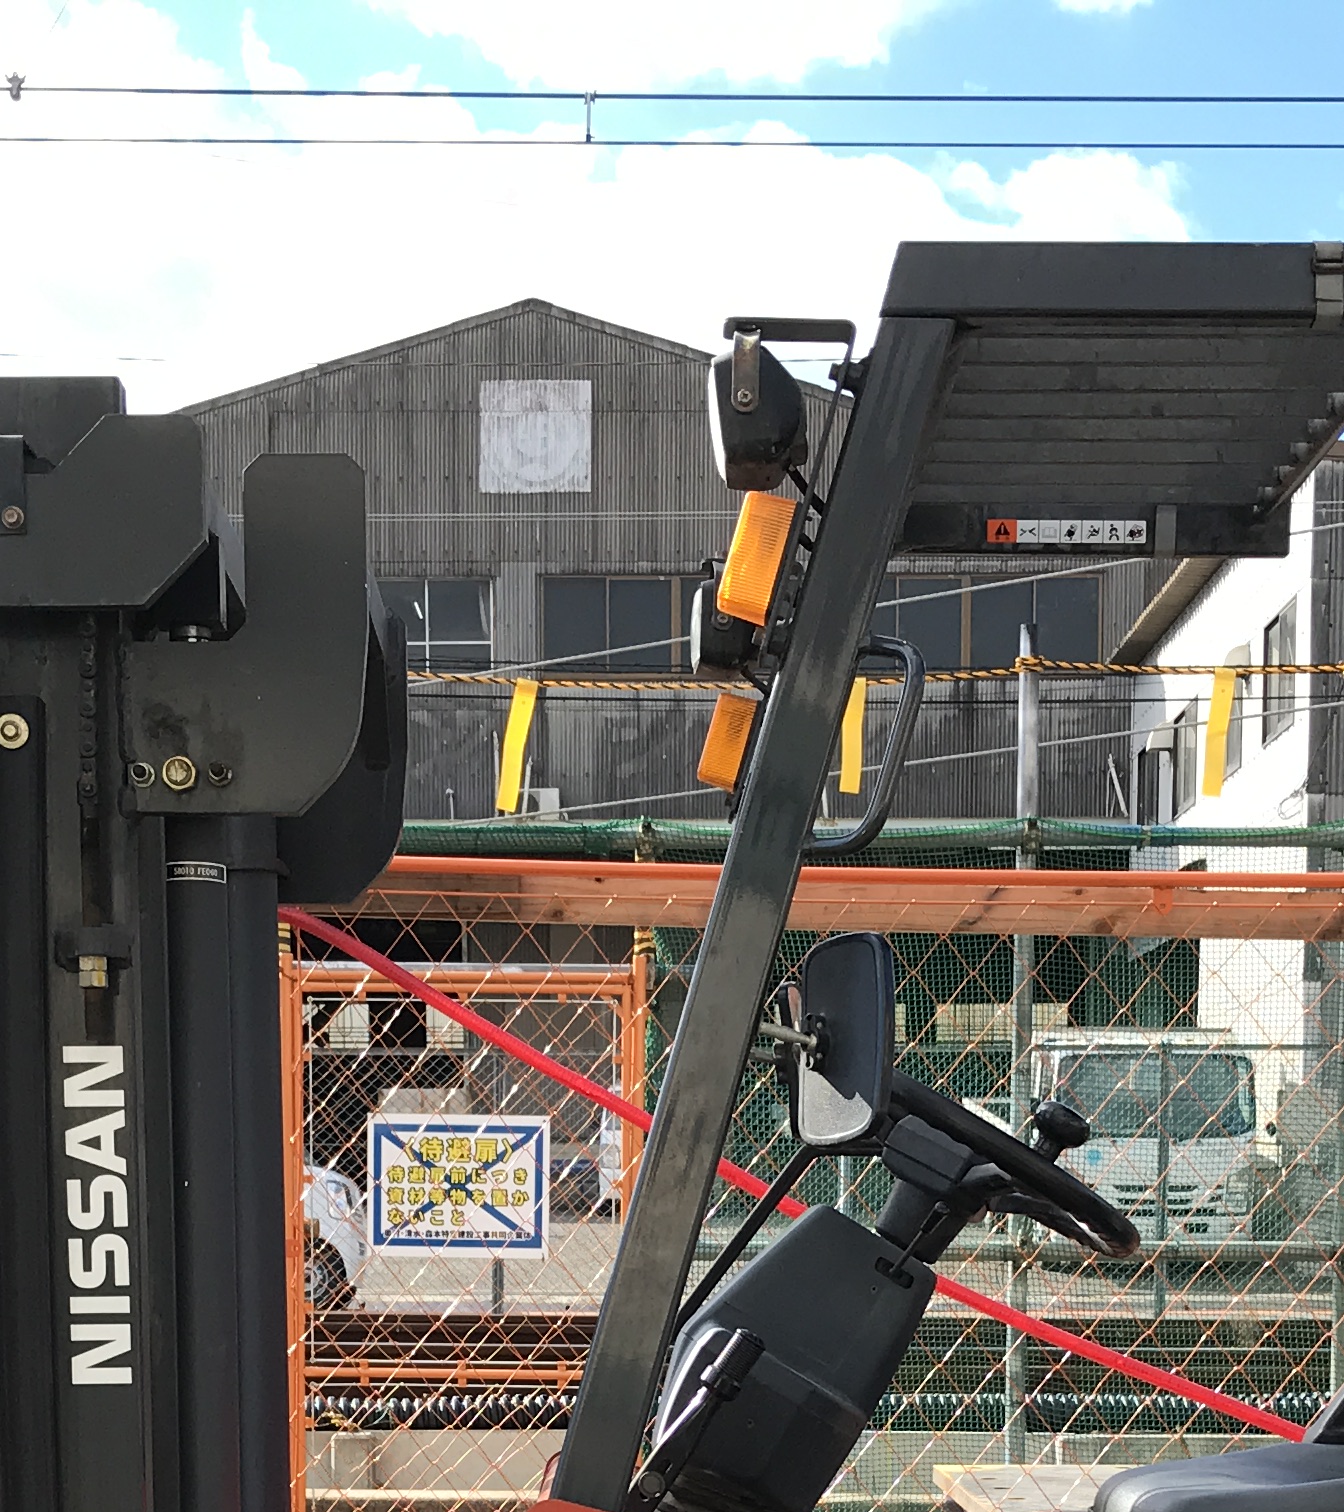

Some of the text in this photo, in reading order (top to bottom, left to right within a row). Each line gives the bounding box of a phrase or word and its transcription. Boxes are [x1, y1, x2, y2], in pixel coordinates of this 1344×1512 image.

[387, 1165, 529, 1186] 待避扉前につき
[62, 1045, 133, 1385] NISSAN
[387, 1208, 466, 1226] ないこと
